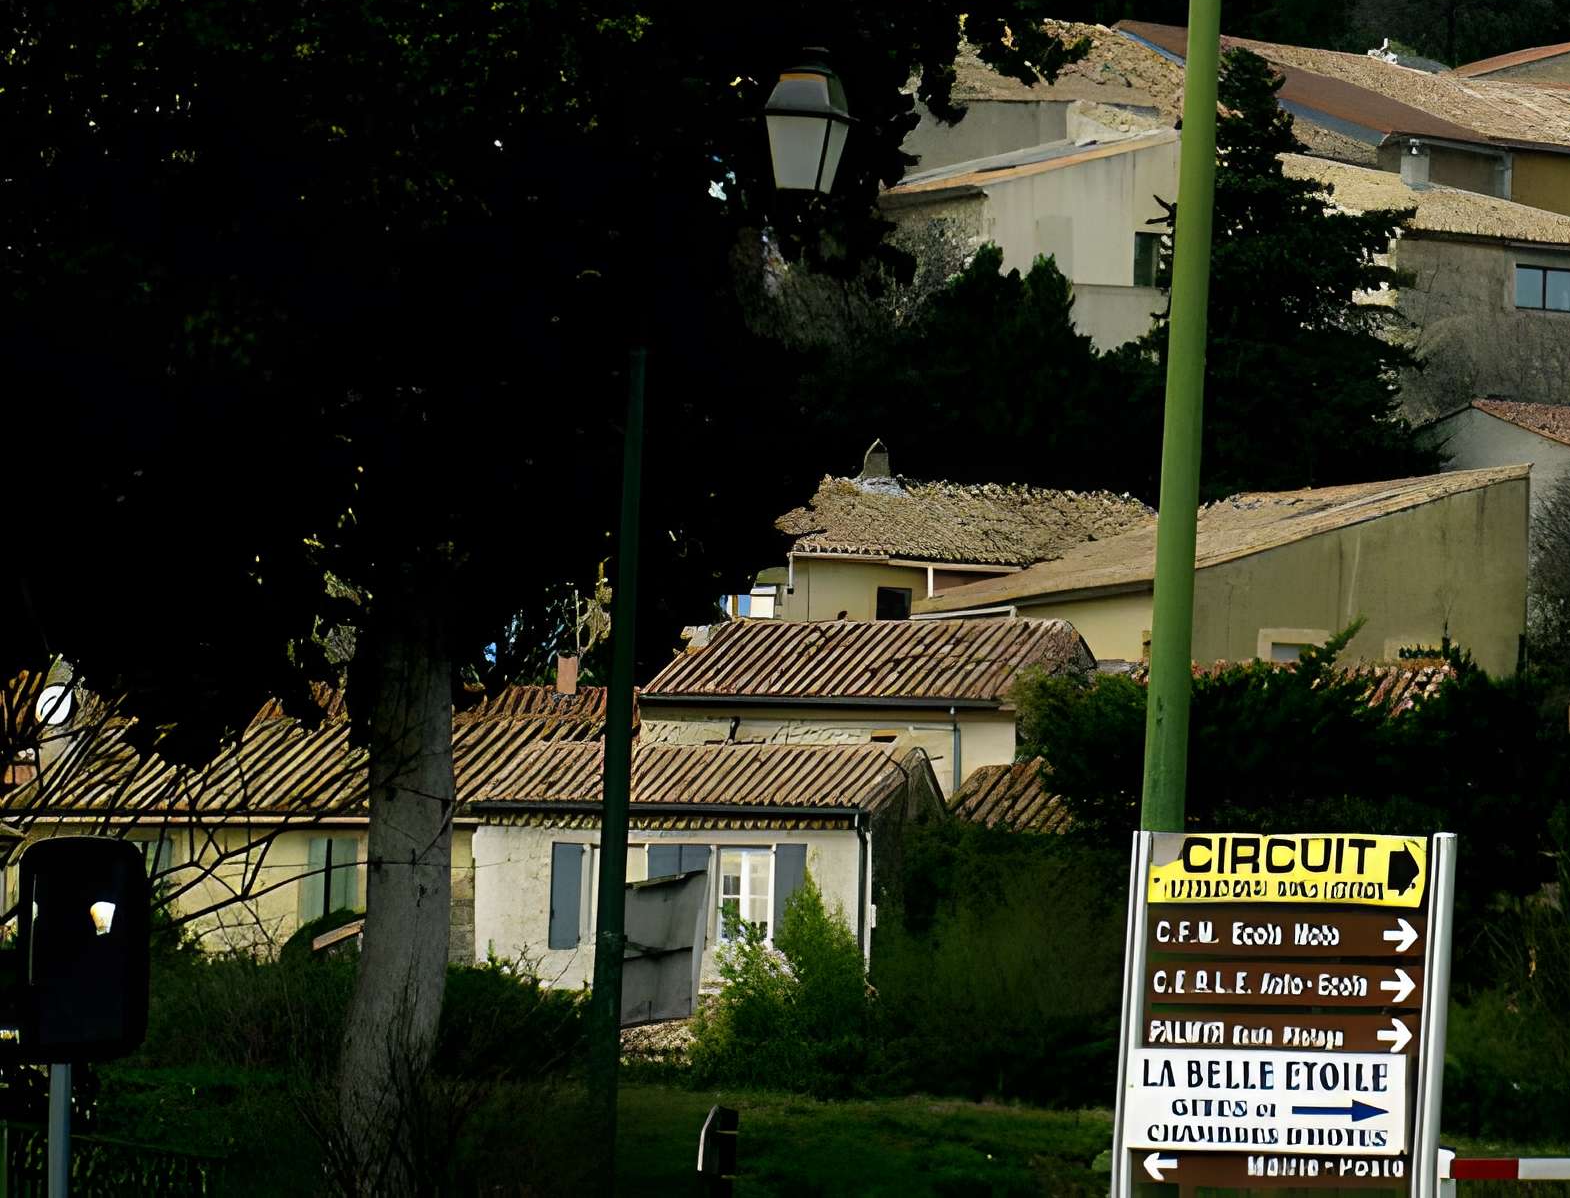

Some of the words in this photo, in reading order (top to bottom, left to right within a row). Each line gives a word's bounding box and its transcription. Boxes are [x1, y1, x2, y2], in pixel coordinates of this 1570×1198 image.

[1182, 836, 1376, 875] CIRCUIT
[1142, 1058, 1177, 1088] LA
[1186, 1059, 1275, 1090] BELLE
[1285, 1061, 1389, 1093] ETOILE
